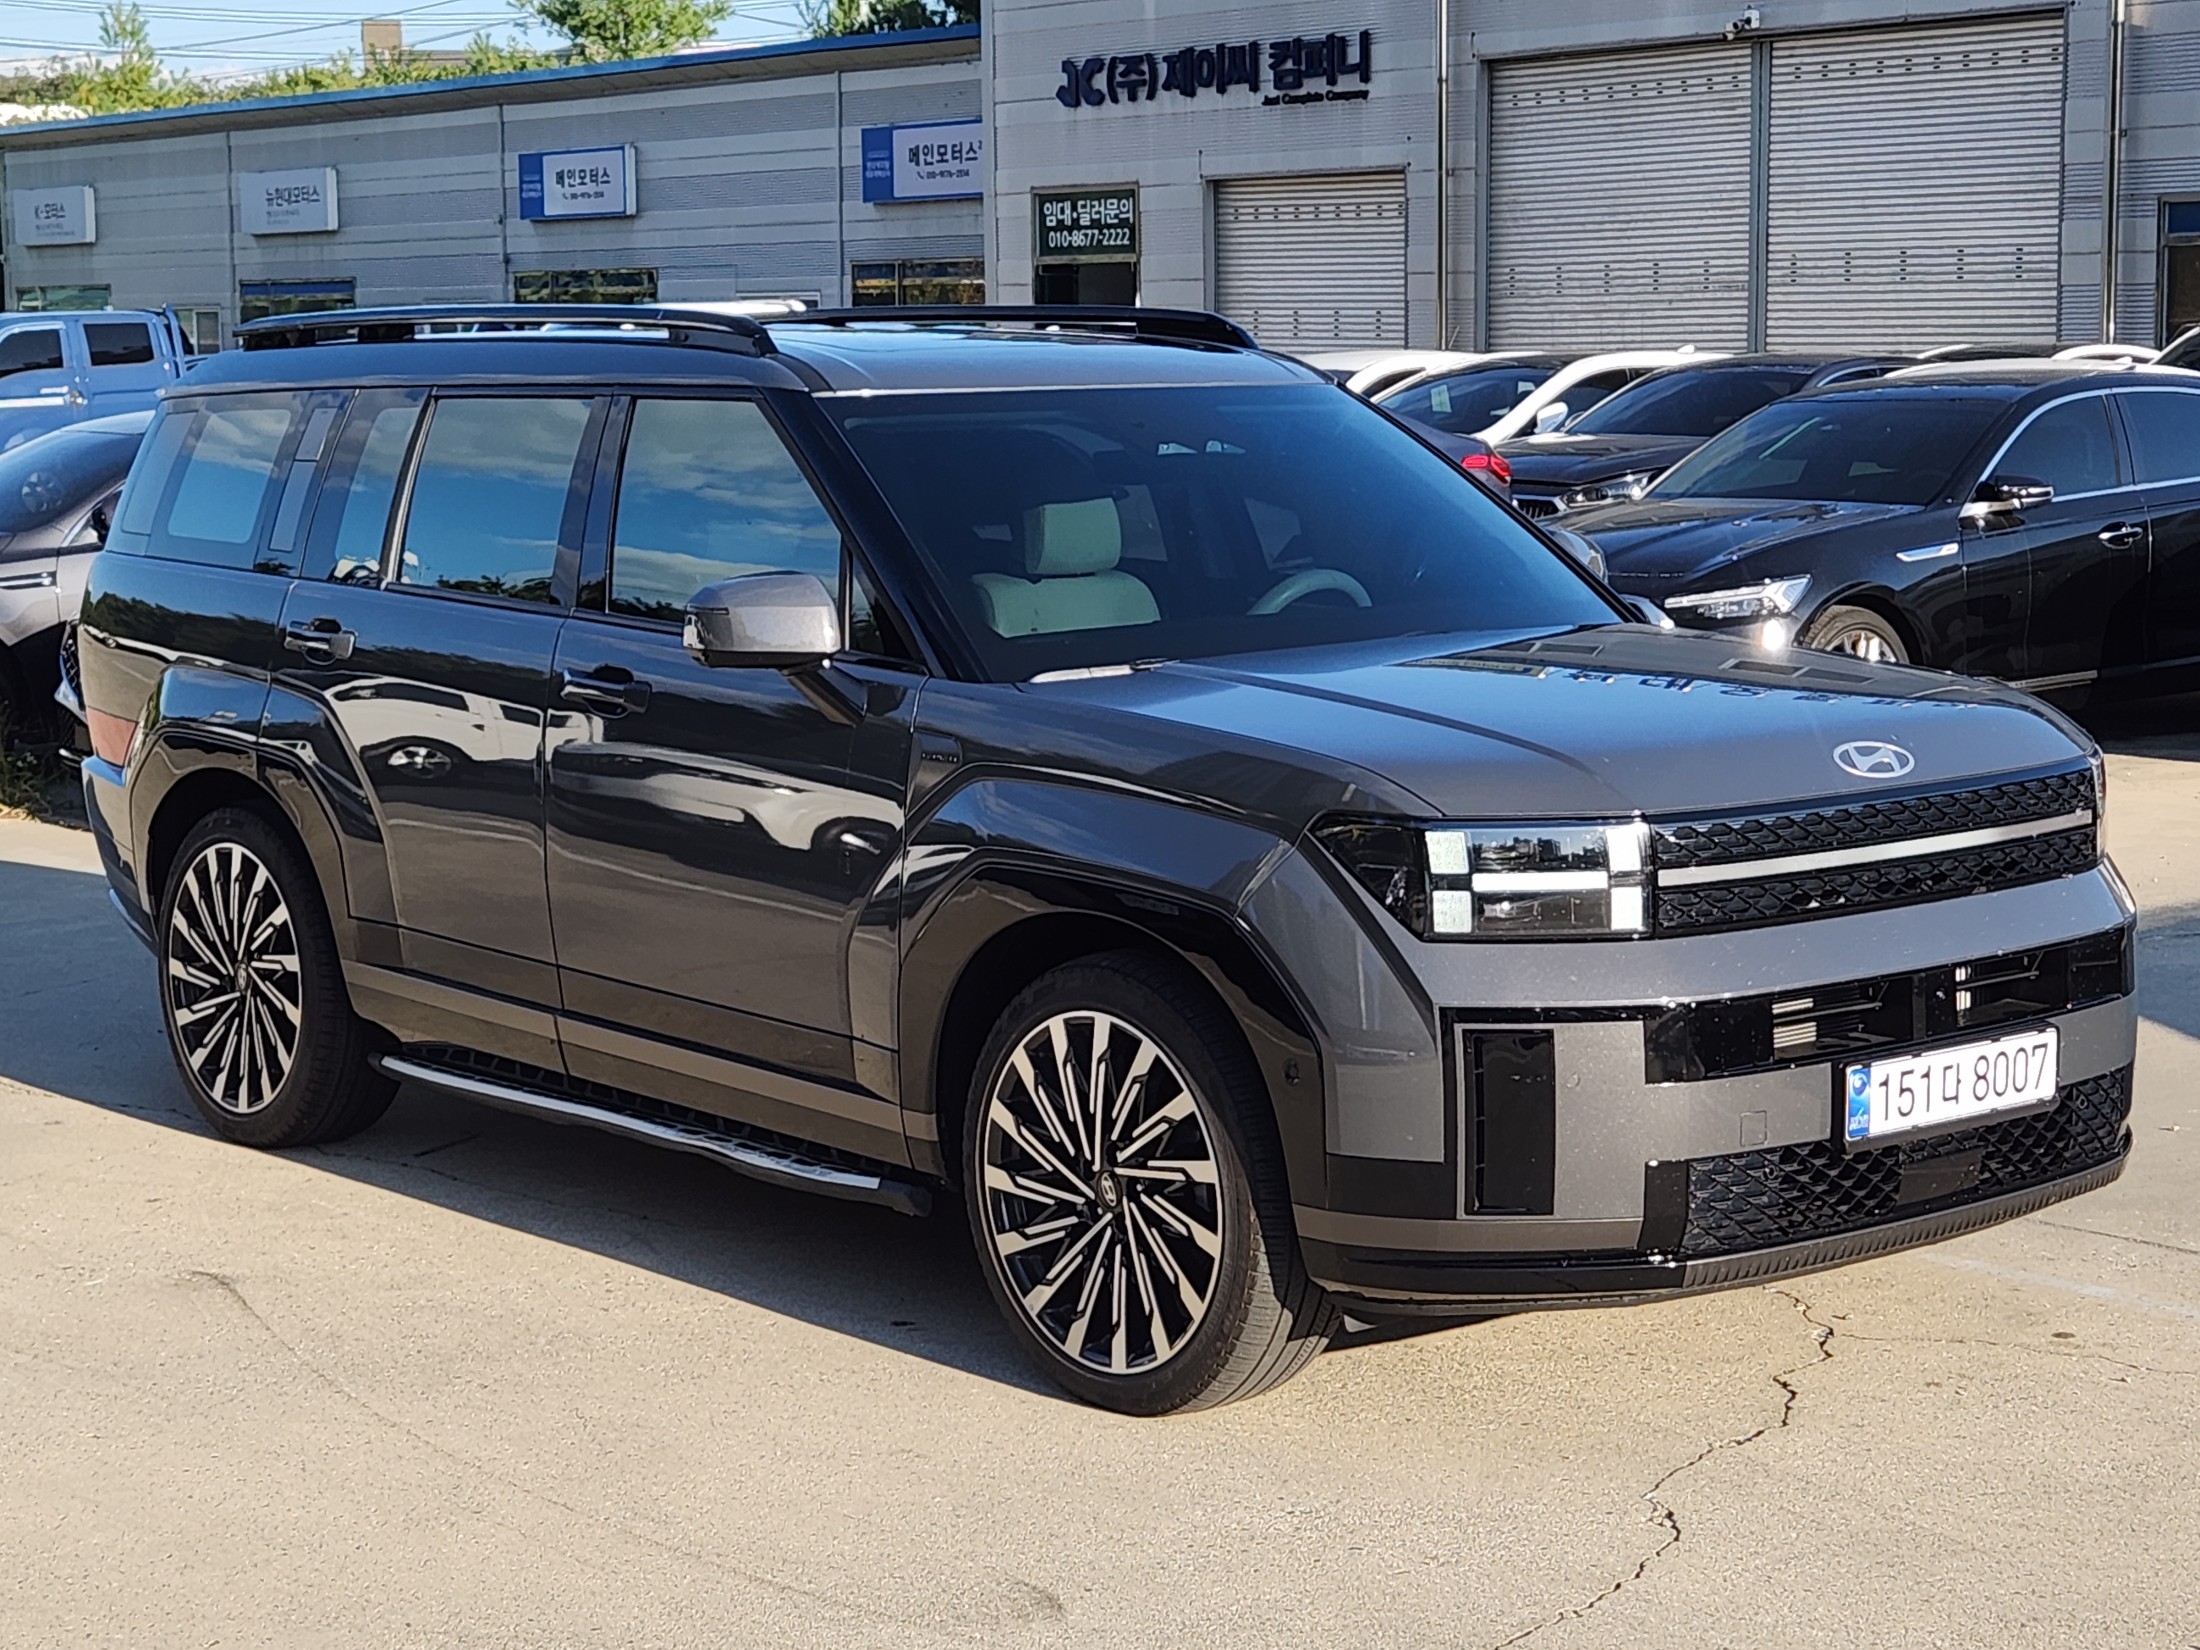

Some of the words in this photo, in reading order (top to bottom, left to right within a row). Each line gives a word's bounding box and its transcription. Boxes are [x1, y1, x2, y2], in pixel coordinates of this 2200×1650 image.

[1268, 30, 1371, 91] 컴퍼니
[908, 141, 979, 167] 메인모터스
[555, 166, 611, 188] 메인모터스
[1048, 227, 1130, 248] 010-8677-2222
[1972, 1043, 2049, 1101] 8007
